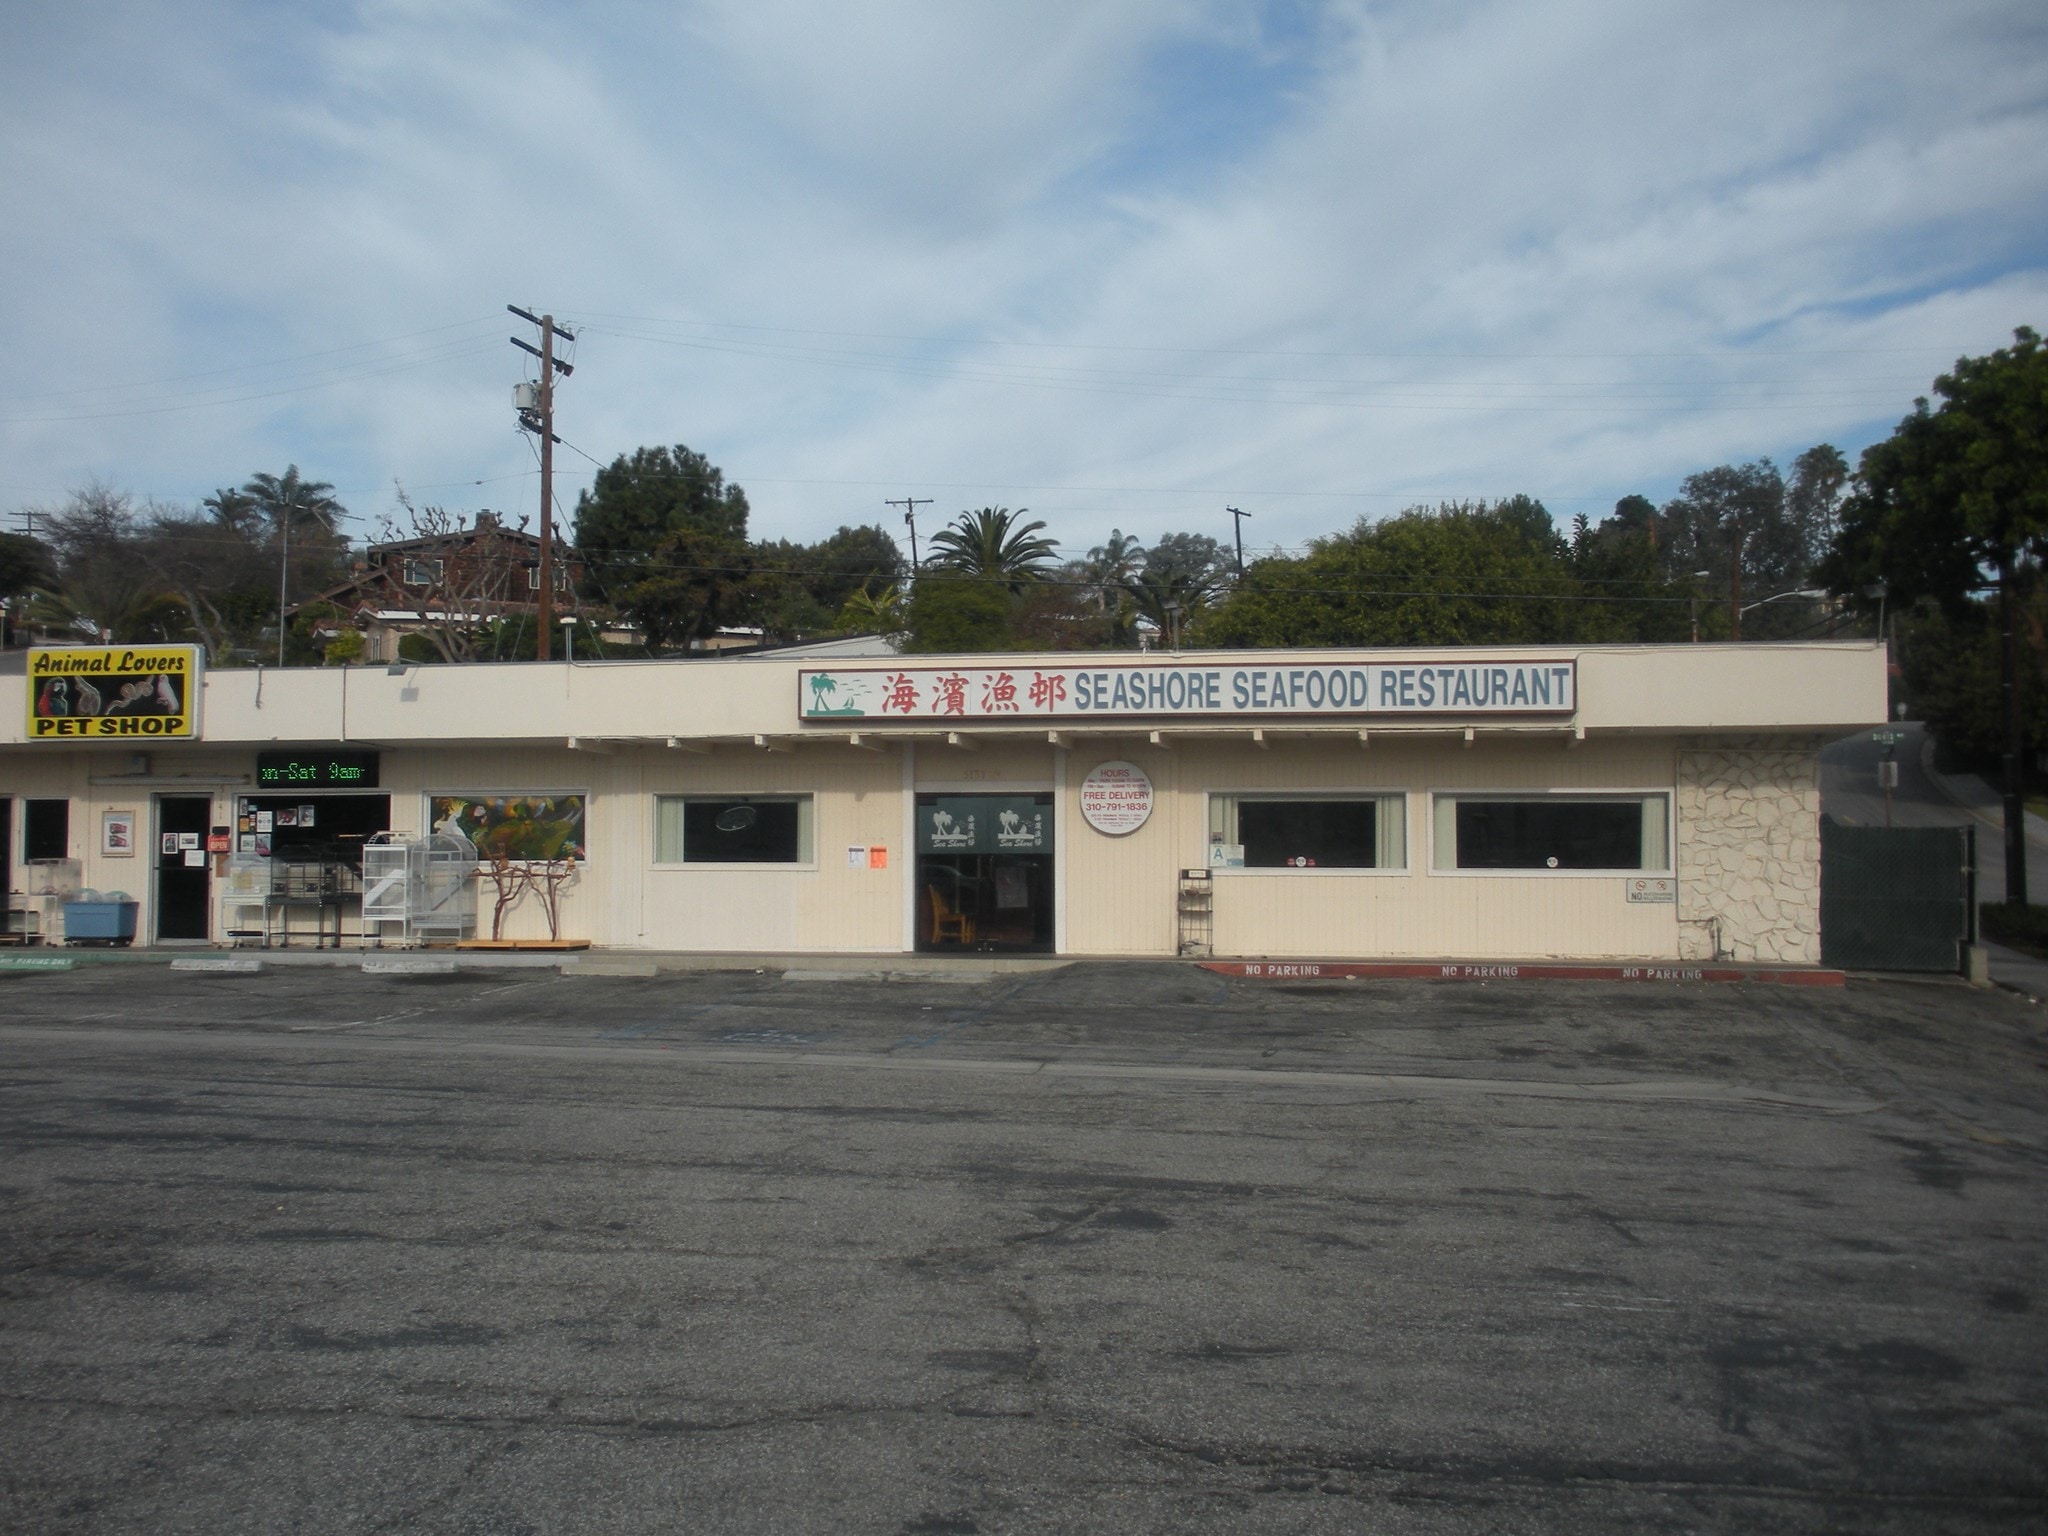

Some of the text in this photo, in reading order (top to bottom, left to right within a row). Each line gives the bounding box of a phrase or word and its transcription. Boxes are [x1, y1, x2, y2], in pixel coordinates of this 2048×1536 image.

[34, 651, 185, 673] Animal Lovers
[881, 671, 1068, 716] 海濱漁邨
[1075, 668, 1570, 710] SEASHORE SEAFOOD RESTAURANT
[37, 717, 184, 735] PET SHOP
[1100, 769, 1130, 777] HOURS
[1084, 791, 1150, 800] FREE DELIVERY
[1086, 803, 1148, 811] 310-791-1836
[1213, 847, 1223, 860] A
[1631, 891, 1643, 900] NO
[1246, 965, 1320, 976] NO PARKING
[1441, 966, 1518, 977] NO PARKING
[1623, 968, 1702, 980] NO PARKING
